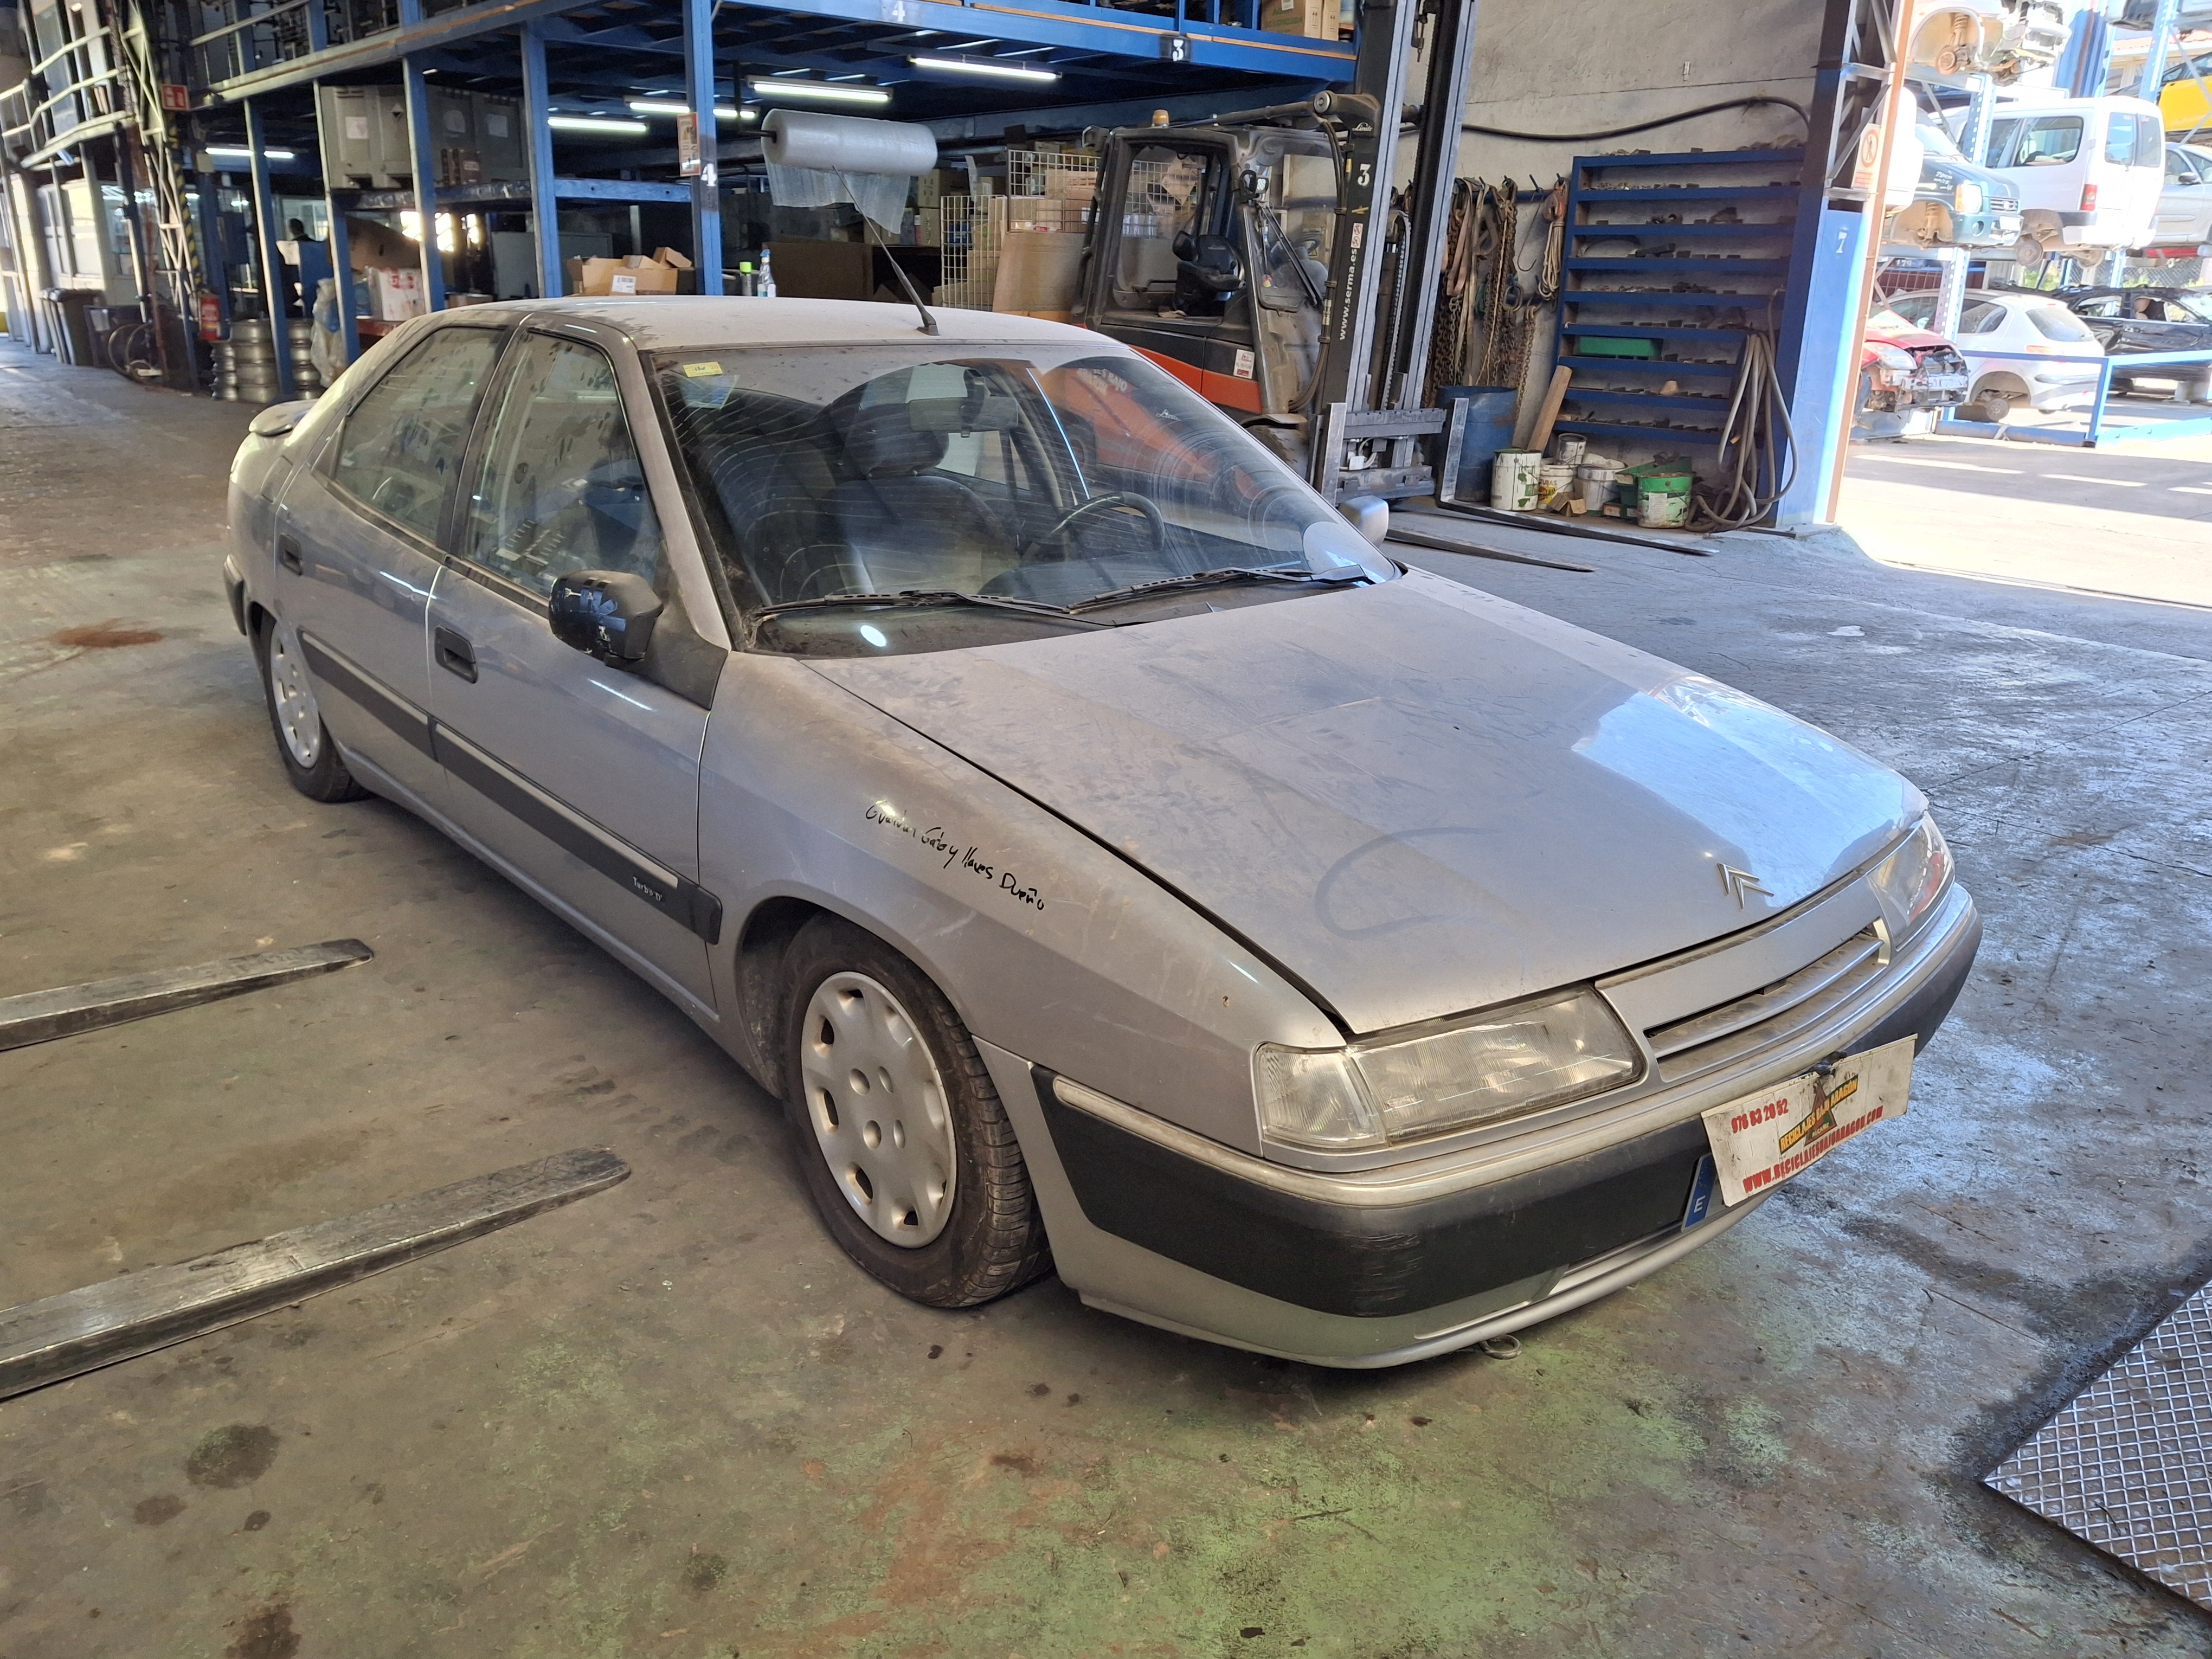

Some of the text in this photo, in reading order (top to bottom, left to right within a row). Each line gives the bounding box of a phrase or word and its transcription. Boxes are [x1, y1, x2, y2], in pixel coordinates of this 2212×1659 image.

[891, 0, 905, 22] 4
[1172, 38, 1184, 61] 3
[700, 163, 717, 187] 4
[1358, 163, 1371, 187] 3
[1836, 231, 1848, 253] 7
[1339, 248, 1357, 340] www.serma.es
[632, 876, 653, 896] Turbo
[999, 872, 1044, 910] Dueño
[1731, 1098, 1789, 1134] 978 83 20 52
[1780, 1113, 1816, 1153] RECICLAJES
[1693, 1195, 1706, 1213] E
